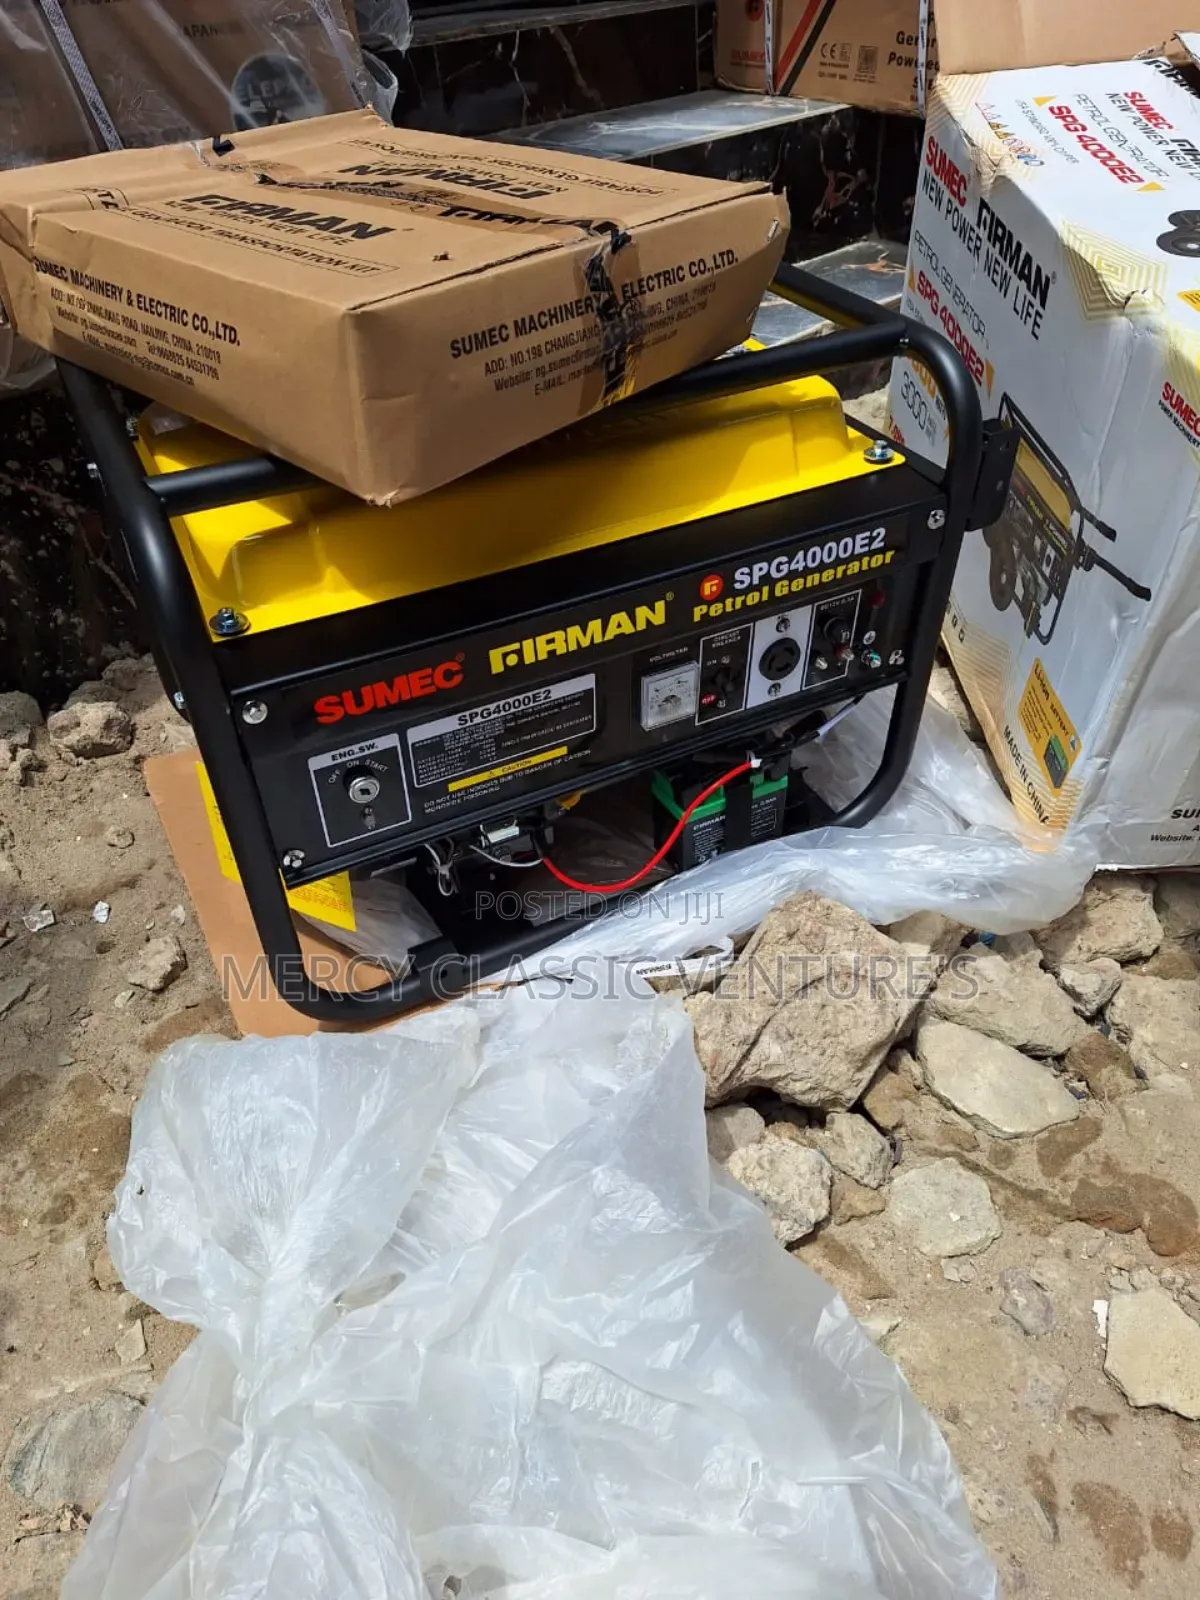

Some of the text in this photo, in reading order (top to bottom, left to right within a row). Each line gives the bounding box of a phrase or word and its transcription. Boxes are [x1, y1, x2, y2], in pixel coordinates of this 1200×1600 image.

[1072, 93, 1111, 127] PETROL
[1105, 92, 1135, 113] NEW
[1126, 114, 1170, 146] POWER
[1161, 149, 1197, 170] NEW
[1123, 91, 1174, 130] SUMEC
[926, 135, 967, 207] SUMEC
[1048, 105, 1146, 184] SPG 4000E2
[337, 164, 553, 199] FIRMAN
[181, 194, 396, 240] FIRMAN
[306, 232, 355, 247] LIFE
[620, 248, 739, 301] ELECTRIC CO.,LTD.
[922, 169, 1044, 341] NEW POWER NEW LIFE
[976, 196, 1051, 311] FIRMAN
[70, 268, 124, 303] MACHINERY
[126, 289, 135, 309] &
[136, 293, 190, 327] ELECTRIC
[191, 313, 241, 347] CO.,LTD.
[914, 229, 941, 278] PETROL
[939, 262, 987, 341] GENERATOR
[450, 323, 510, 360] SUMEC
[513, 292, 601, 337] MACHINERY
[916, 271, 940, 315] SPG
[939, 305, 986, 387] 4000E2
[484, 358, 509, 377] ADD:
[510, 346, 543, 366] NO.198
[494, 369, 534, 391] Website:
[900, 371, 927, 431] 3000
[1162, 381, 1200, 437] SUMEC
[693, 550, 895, 622] Petrol Generator
[733, 527, 886, 590] SPG4000E2
[488, 600, 666, 675] FIRMAN
[314, 660, 464, 724] SUMEC
[458, 689, 553, 726] SPG4000E2
[328, 769, 341, 784] OFF
[331, 742, 380, 761] ENG.SW.
[346, 759, 360, 768] ON
[364, 759, 389, 773] START
[1003, 725, 1050, 825] MADE IN CHINA
